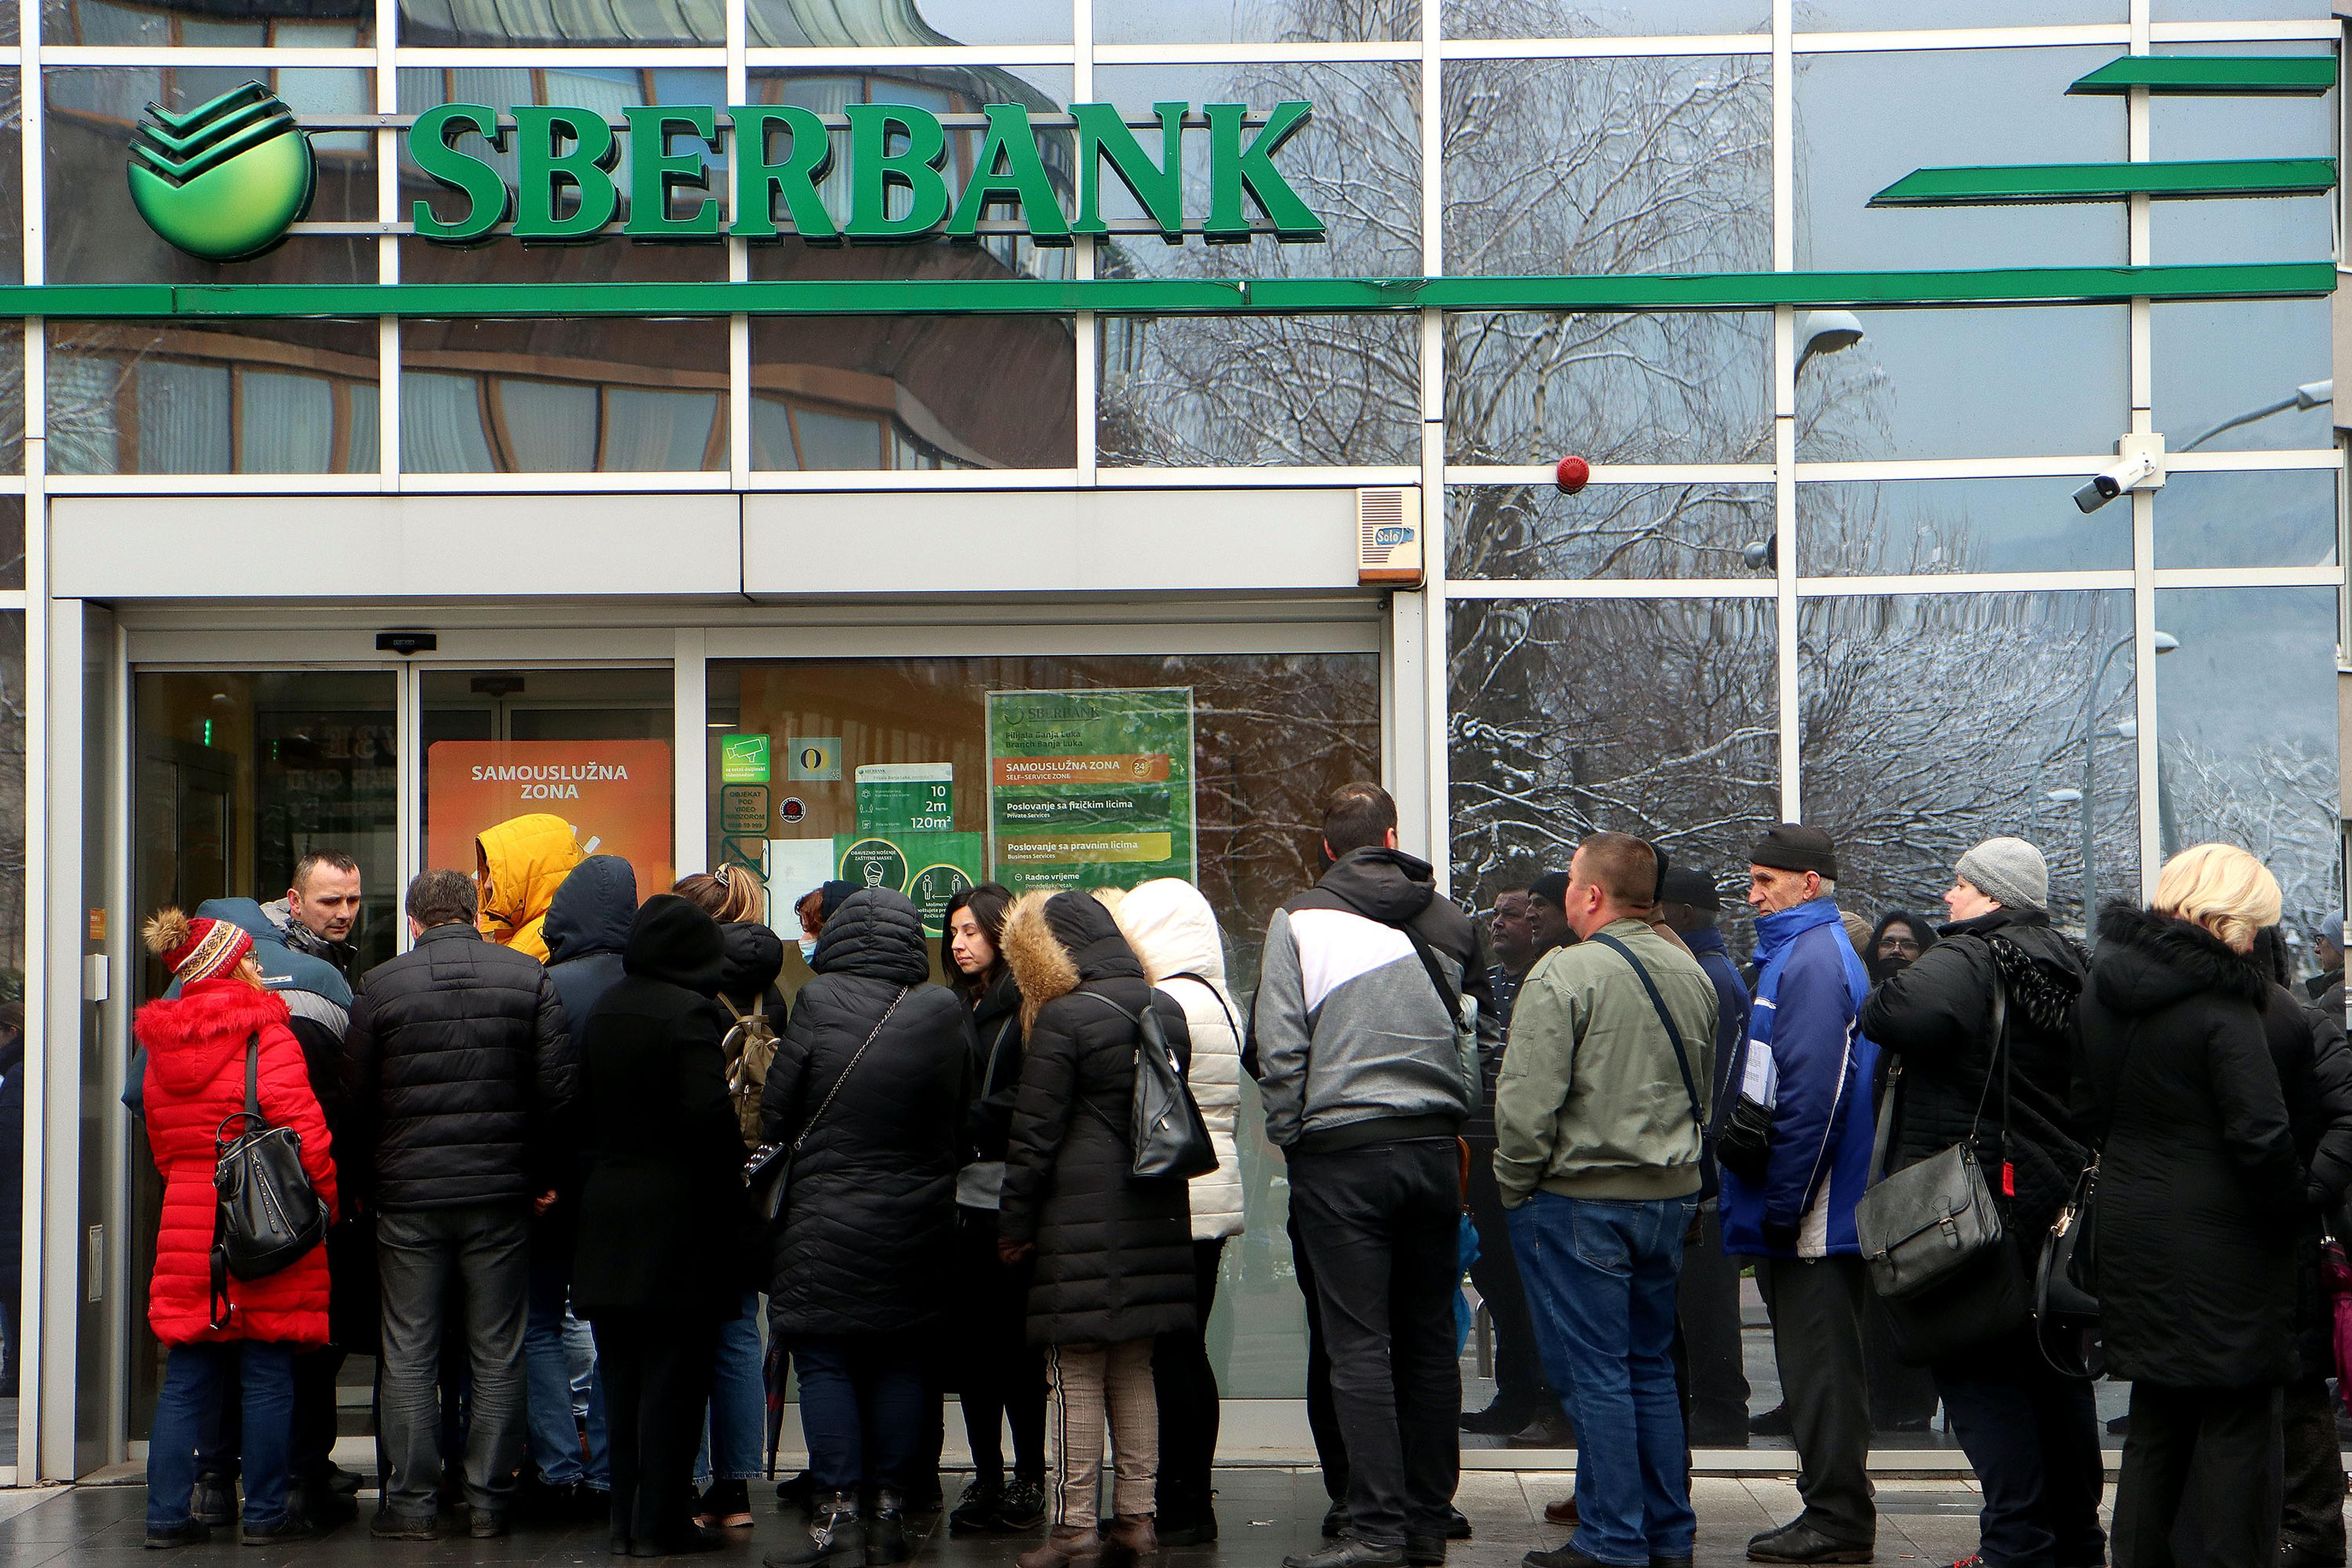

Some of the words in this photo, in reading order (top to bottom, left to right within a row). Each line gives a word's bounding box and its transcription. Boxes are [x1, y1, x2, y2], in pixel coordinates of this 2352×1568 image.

[409, 101, 1327, 238] SBERBANK
[1377, 530, 1399, 543] Solo
[1006, 731, 1033, 740] Filijala
[1035, 731, 1058, 741] Banja
[1037, 740, 1061, 748] Banja
[472, 761, 628, 780] SAMOUSLUŽNA
[1006, 760, 1087, 772] SAMOUSLUŽNA
[1090, 761, 1120, 770] ZONA
[1134, 762, 1145, 770] 24
[520, 784, 579, 799] ZONA
[931, 785, 946, 797] 10
[926, 801, 947, 812] 2m
[1007, 802, 1055, 811] Poslovanje
[1069, 801, 1104, 811] fizičkim
[1106, 800, 1133, 808] licima
[1008, 842, 1056, 852] Poslovanje
[1071, 841, 1108, 851] pravnim
[1111, 841, 1139, 849] licima
[1051, 873, 1080, 882] vrijeme
